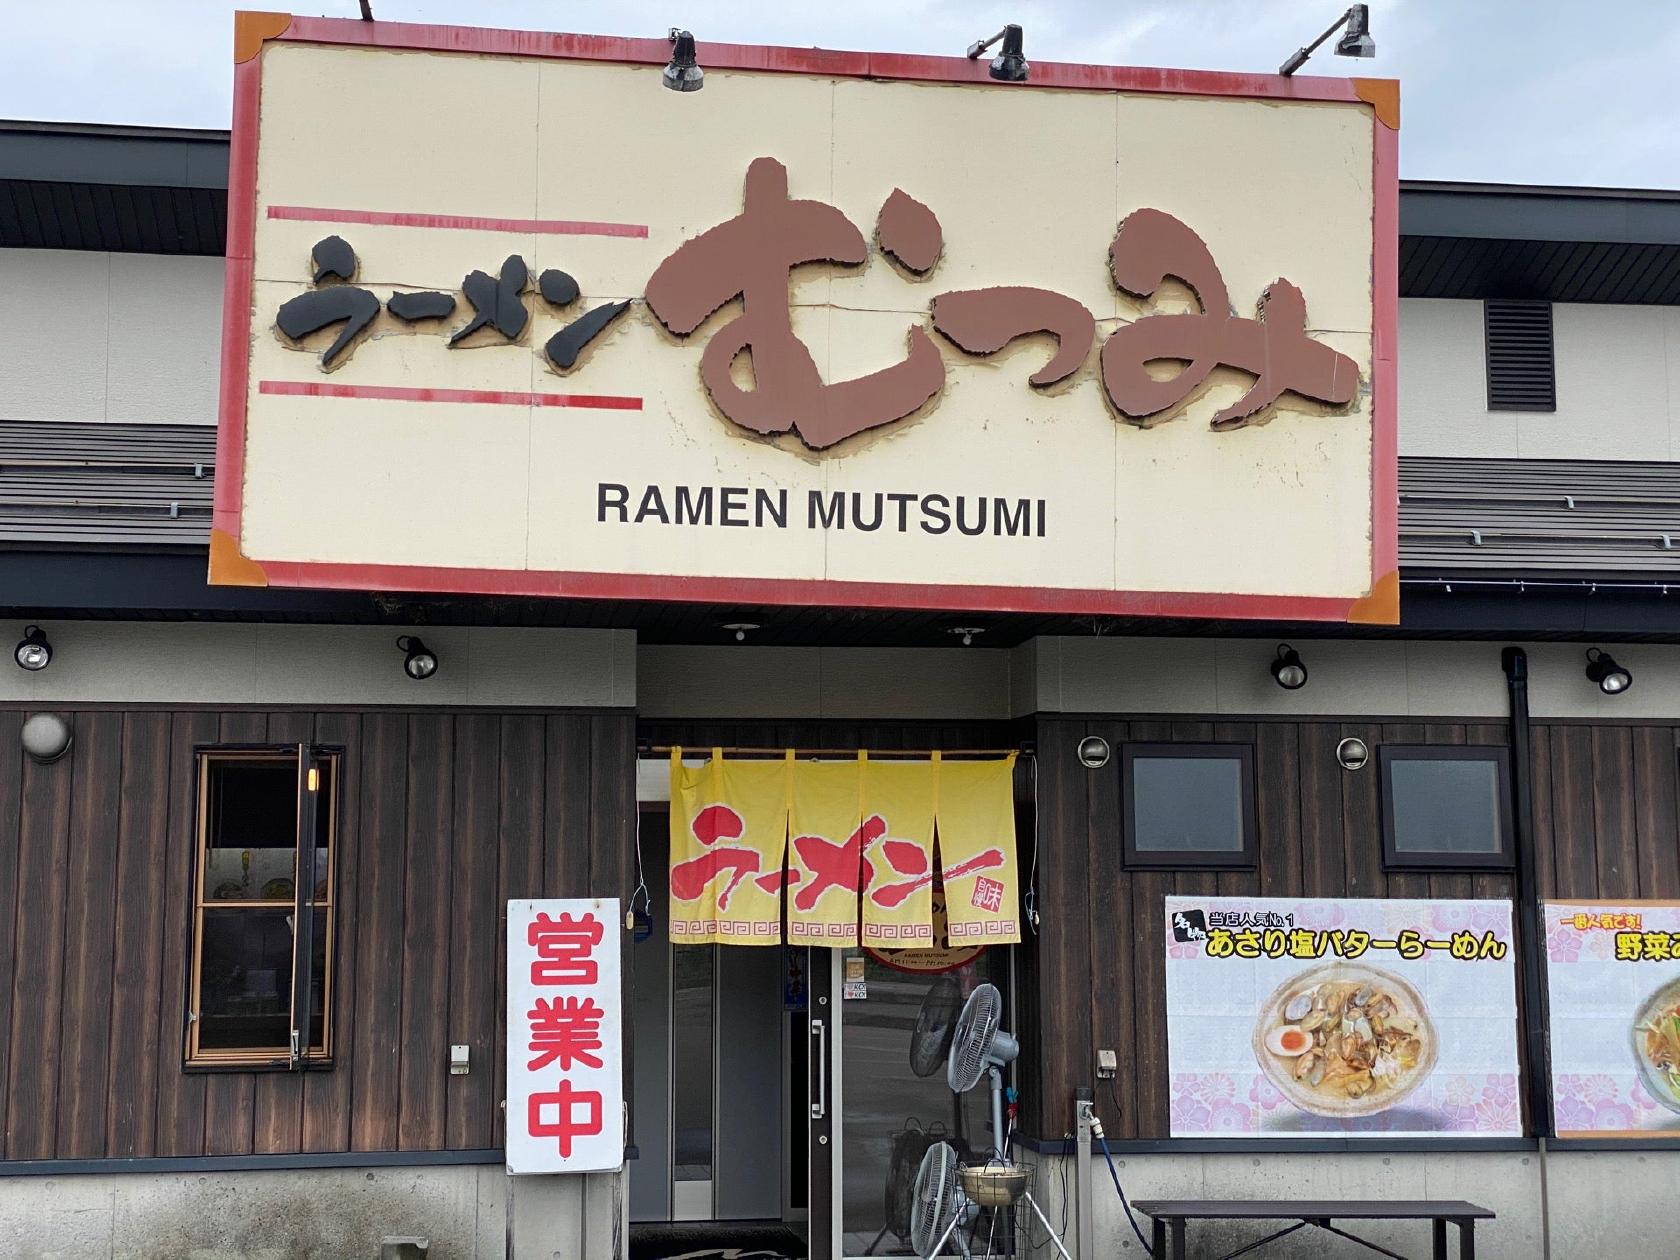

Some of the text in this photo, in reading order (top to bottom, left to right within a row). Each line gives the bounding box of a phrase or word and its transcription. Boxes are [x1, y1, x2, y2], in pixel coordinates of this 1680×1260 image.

[276, 235, 633, 370] ラーメン
[645, 156, 1361, 451] むつみ
[597, 483, 1047, 537] RAMEN MUTSUMI
[671, 805, 1005, 911] ラーメン
[1206, 928, 1506, 961] あさり塩バターらーめん
[527, 911, 605, 1159] 営業中
